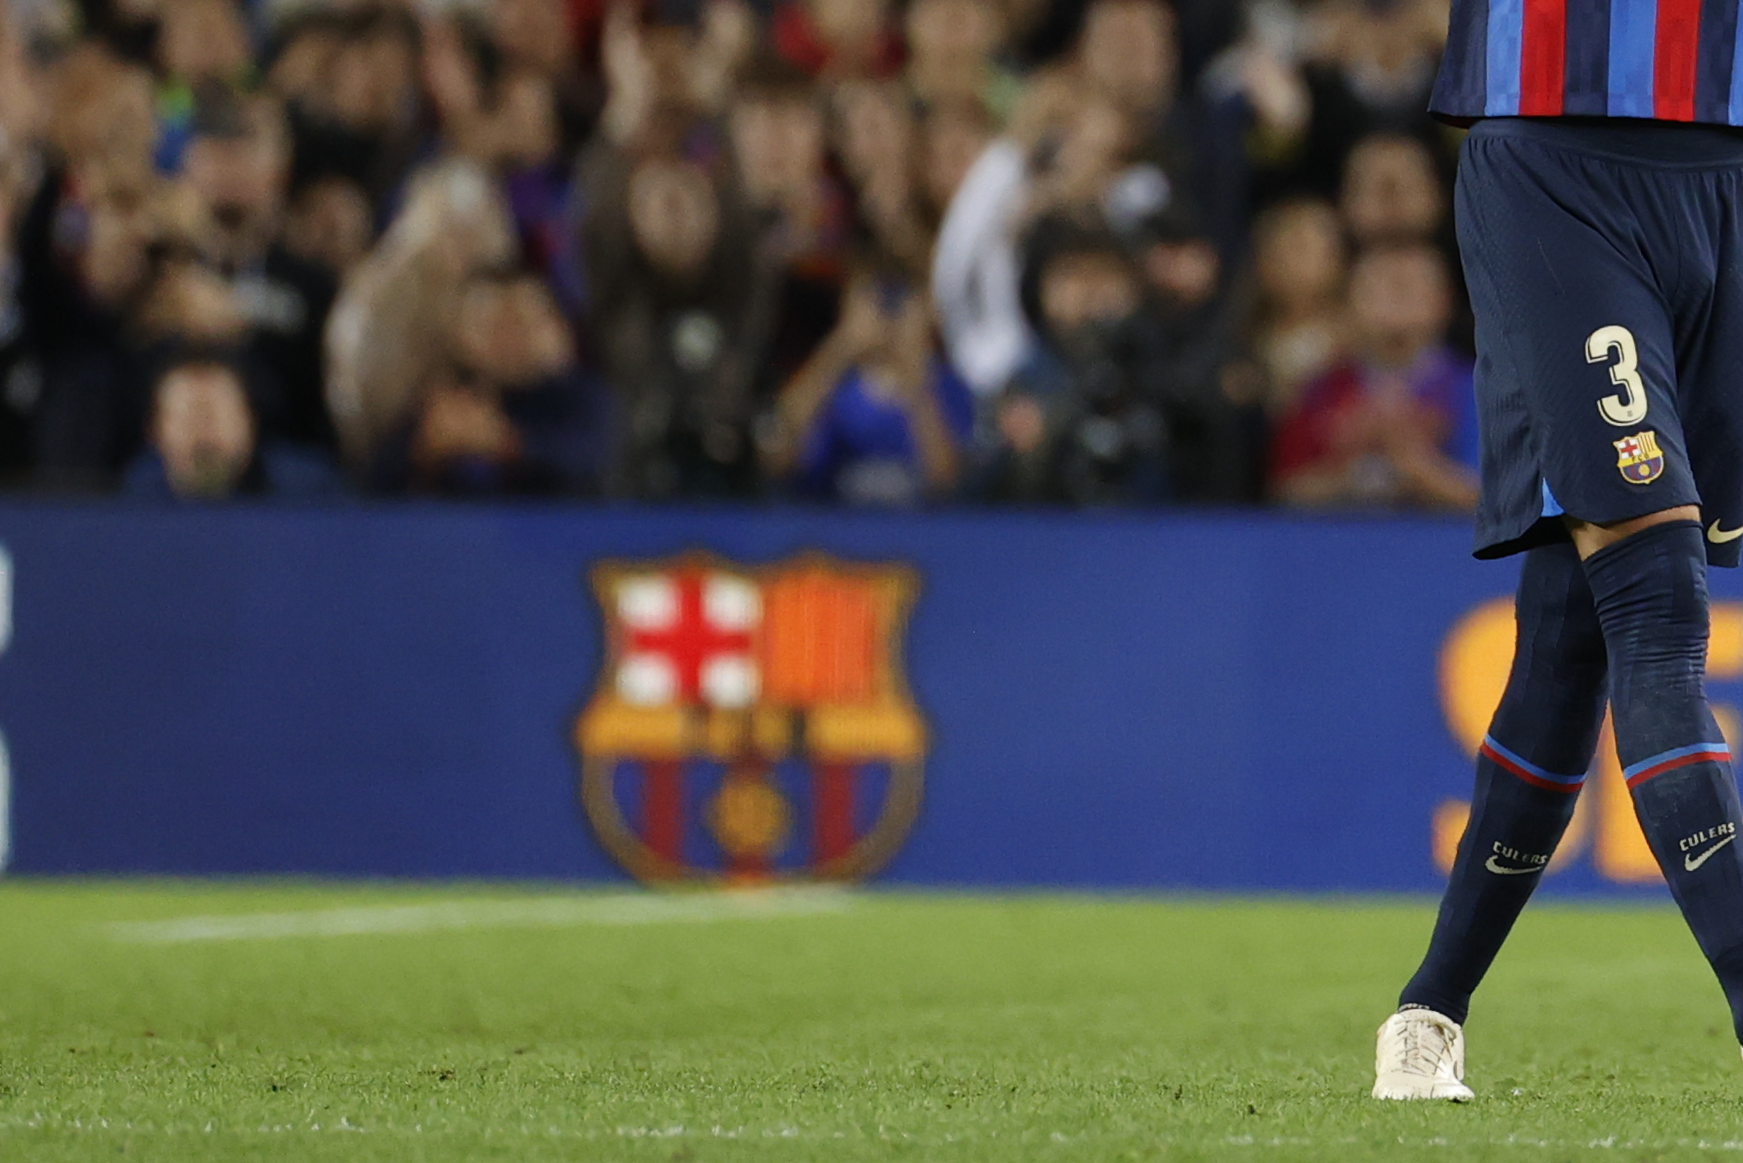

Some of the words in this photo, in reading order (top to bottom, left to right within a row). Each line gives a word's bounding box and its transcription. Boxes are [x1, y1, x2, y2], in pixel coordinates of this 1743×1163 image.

[1585, 325, 1648, 427] 3
[1680, 822, 1735, 851] CULERS
[1492, 841, 1548, 864] CULERS
